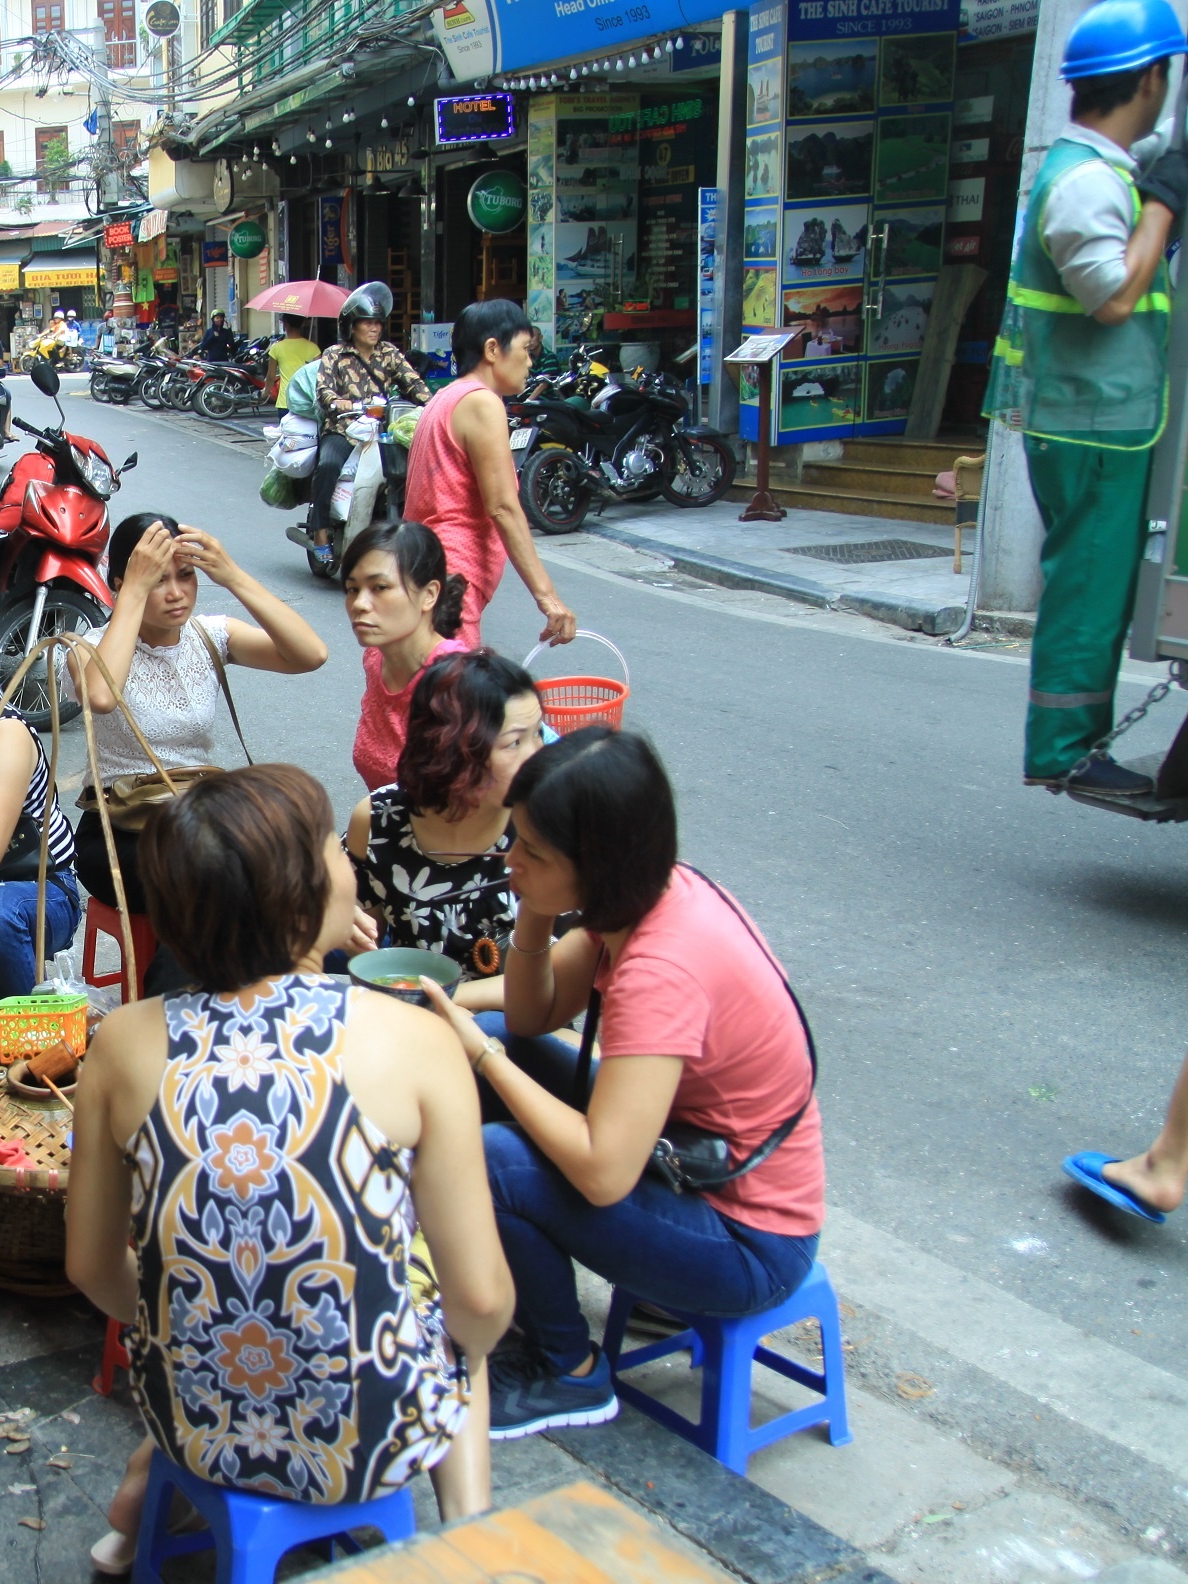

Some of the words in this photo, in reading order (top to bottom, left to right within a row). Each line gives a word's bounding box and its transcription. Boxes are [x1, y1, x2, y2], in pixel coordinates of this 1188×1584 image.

[554, 0, 586, 18] Head
[799, 1, 824, 19] THE
[826, 0, 859, 18] SINH
[862, 0, 893, 15] CAFE
[595, 15, 624, 32] Since
[624, 5, 651, 23] 1993
[750, 14, 759, 32] THE
[836, 20, 876, 34] SINCE
[881, 17, 912, 32] 1993
[453, 99, 497, 114] HOTEL
[486, 194, 522, 209] TUBORG
[955, 193, 979, 206] THAI
[109, 225, 130, 236] BOOK
[108, 234, 133, 244] POSTER
[814, 267, 833, 277] Long
[433, 331, 449, 339] Tiger
